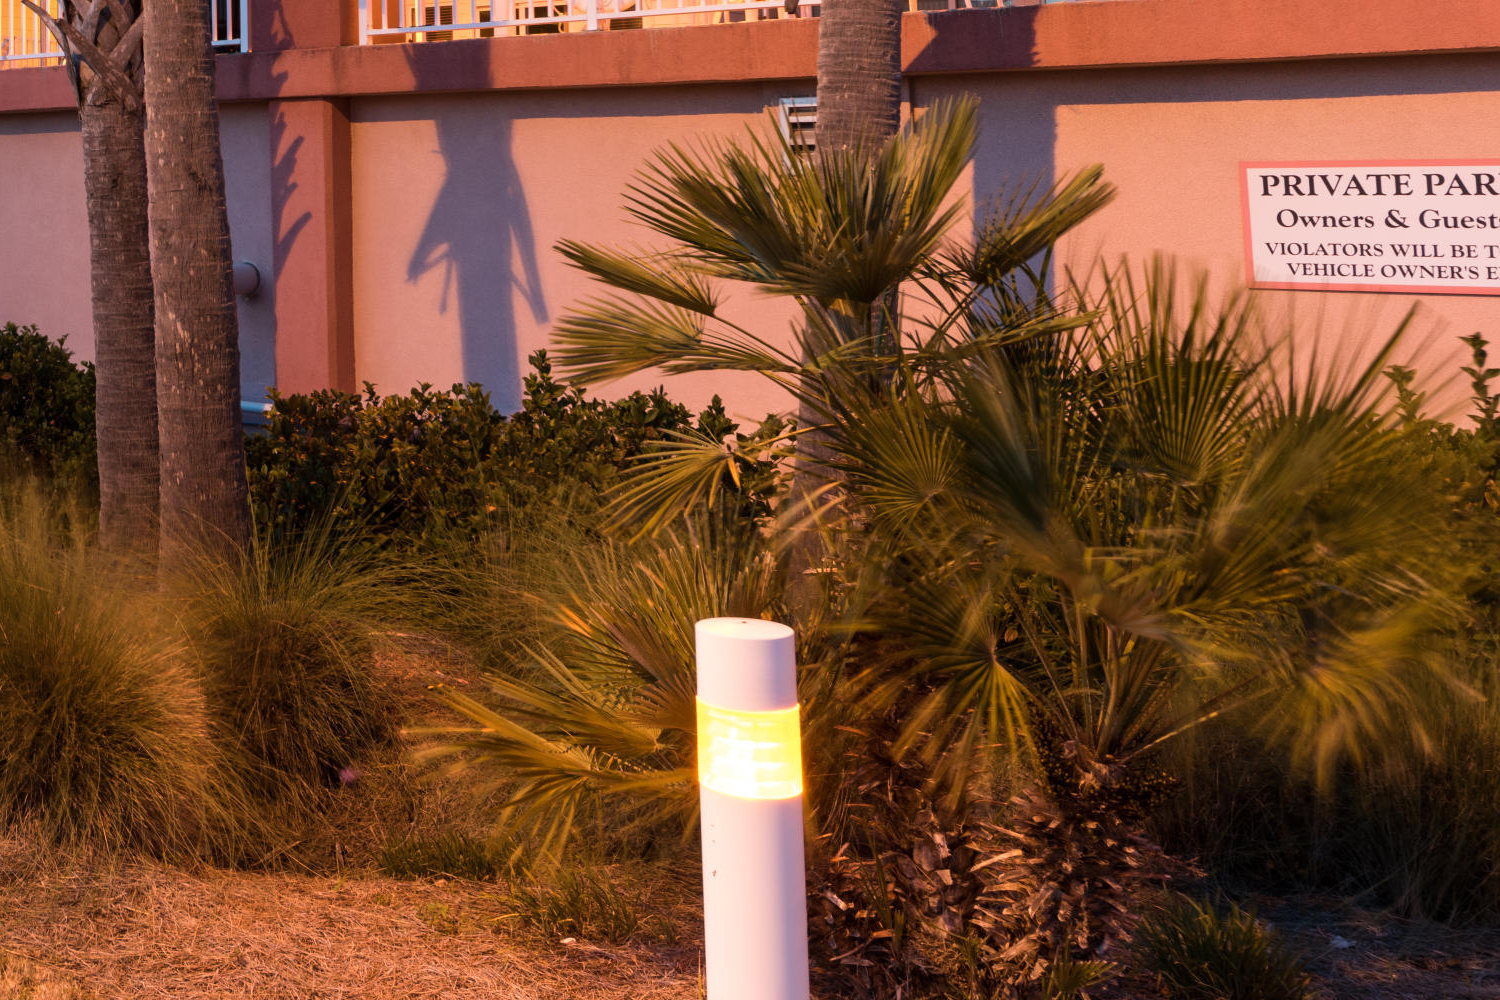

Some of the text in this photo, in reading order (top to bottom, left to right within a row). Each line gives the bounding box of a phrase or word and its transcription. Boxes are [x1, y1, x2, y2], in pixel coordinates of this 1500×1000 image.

[1260, 173, 1500, 196] PRIVATE PAR
[1276, 209, 1500, 229] Owners & Guest
[1264, 242, 1500, 258] VIOLATORS WILL BE T
[1287, 262, 1500, 280] VEHICLE OWNER'S E
